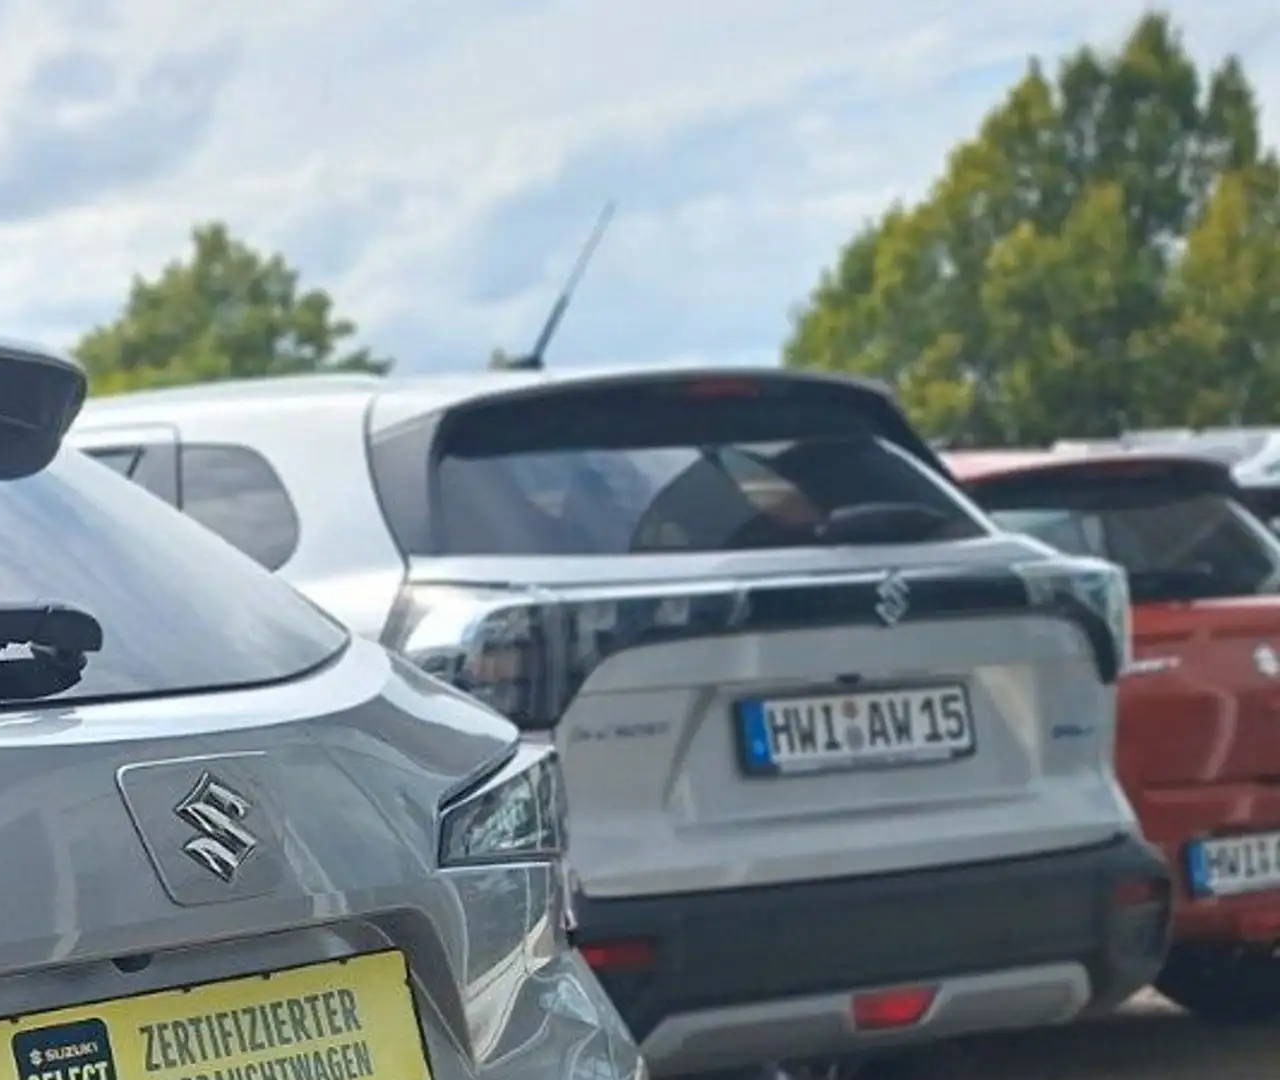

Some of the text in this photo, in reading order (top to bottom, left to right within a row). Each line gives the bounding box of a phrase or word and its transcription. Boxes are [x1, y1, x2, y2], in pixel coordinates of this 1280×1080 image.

[768, 693, 966, 754] HWI AW 15
[44, 1041, 99, 1063] SUZUKI
[138, 987, 362, 1072] ZERTIFIZIERTER
